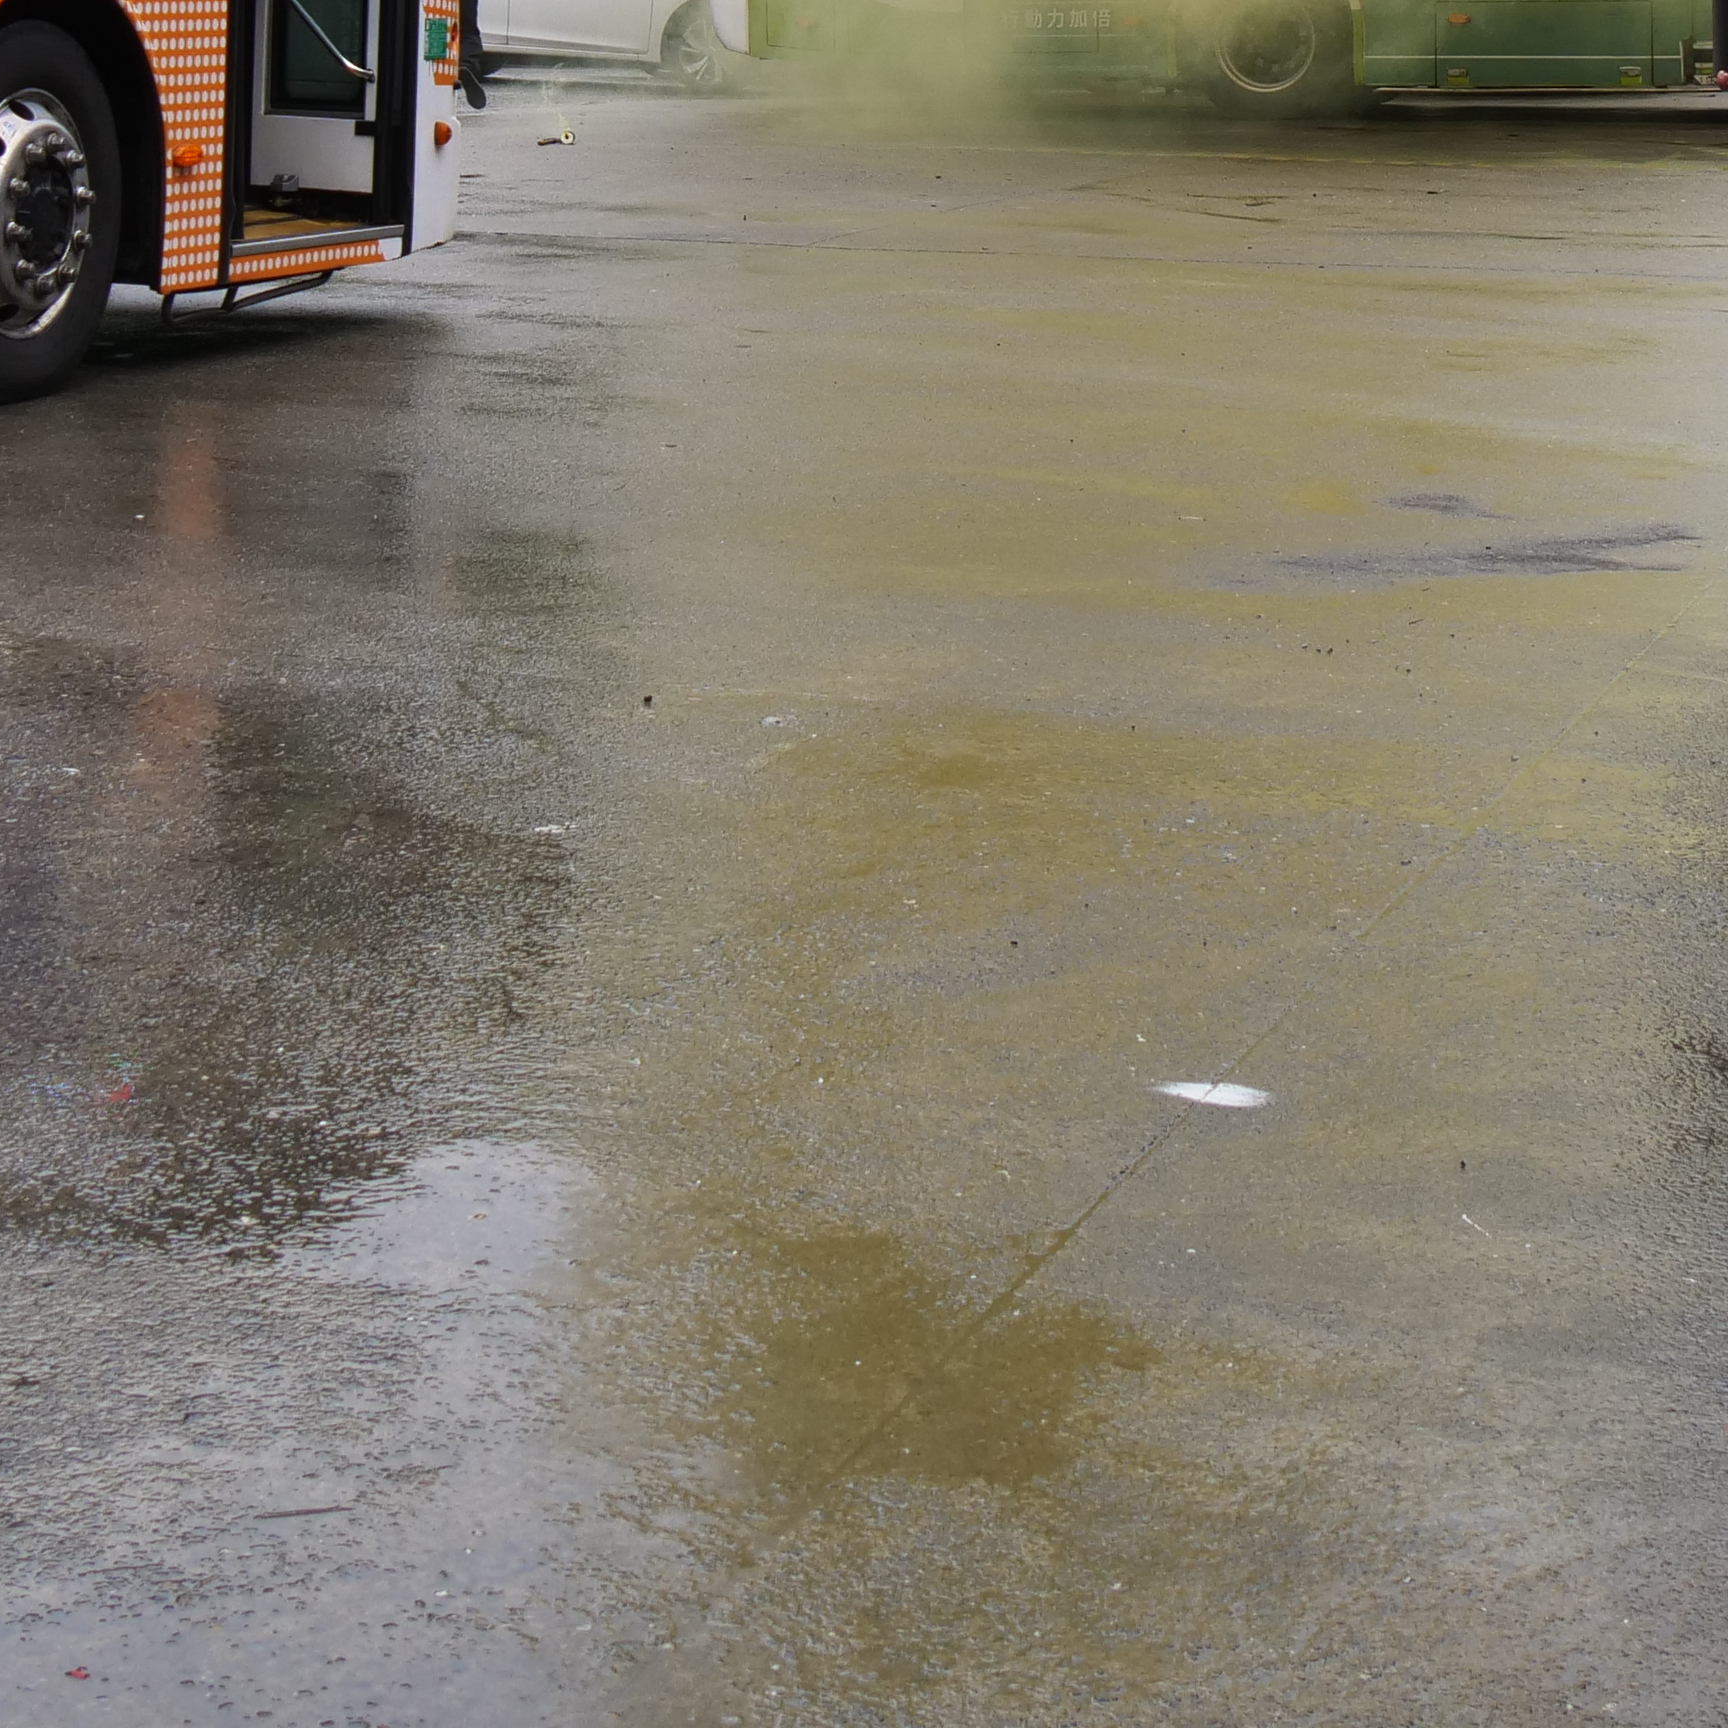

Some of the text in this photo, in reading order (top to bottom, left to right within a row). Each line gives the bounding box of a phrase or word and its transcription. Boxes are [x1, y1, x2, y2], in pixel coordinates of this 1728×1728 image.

[1003, 8, 1112, 29] 行動力加倍
